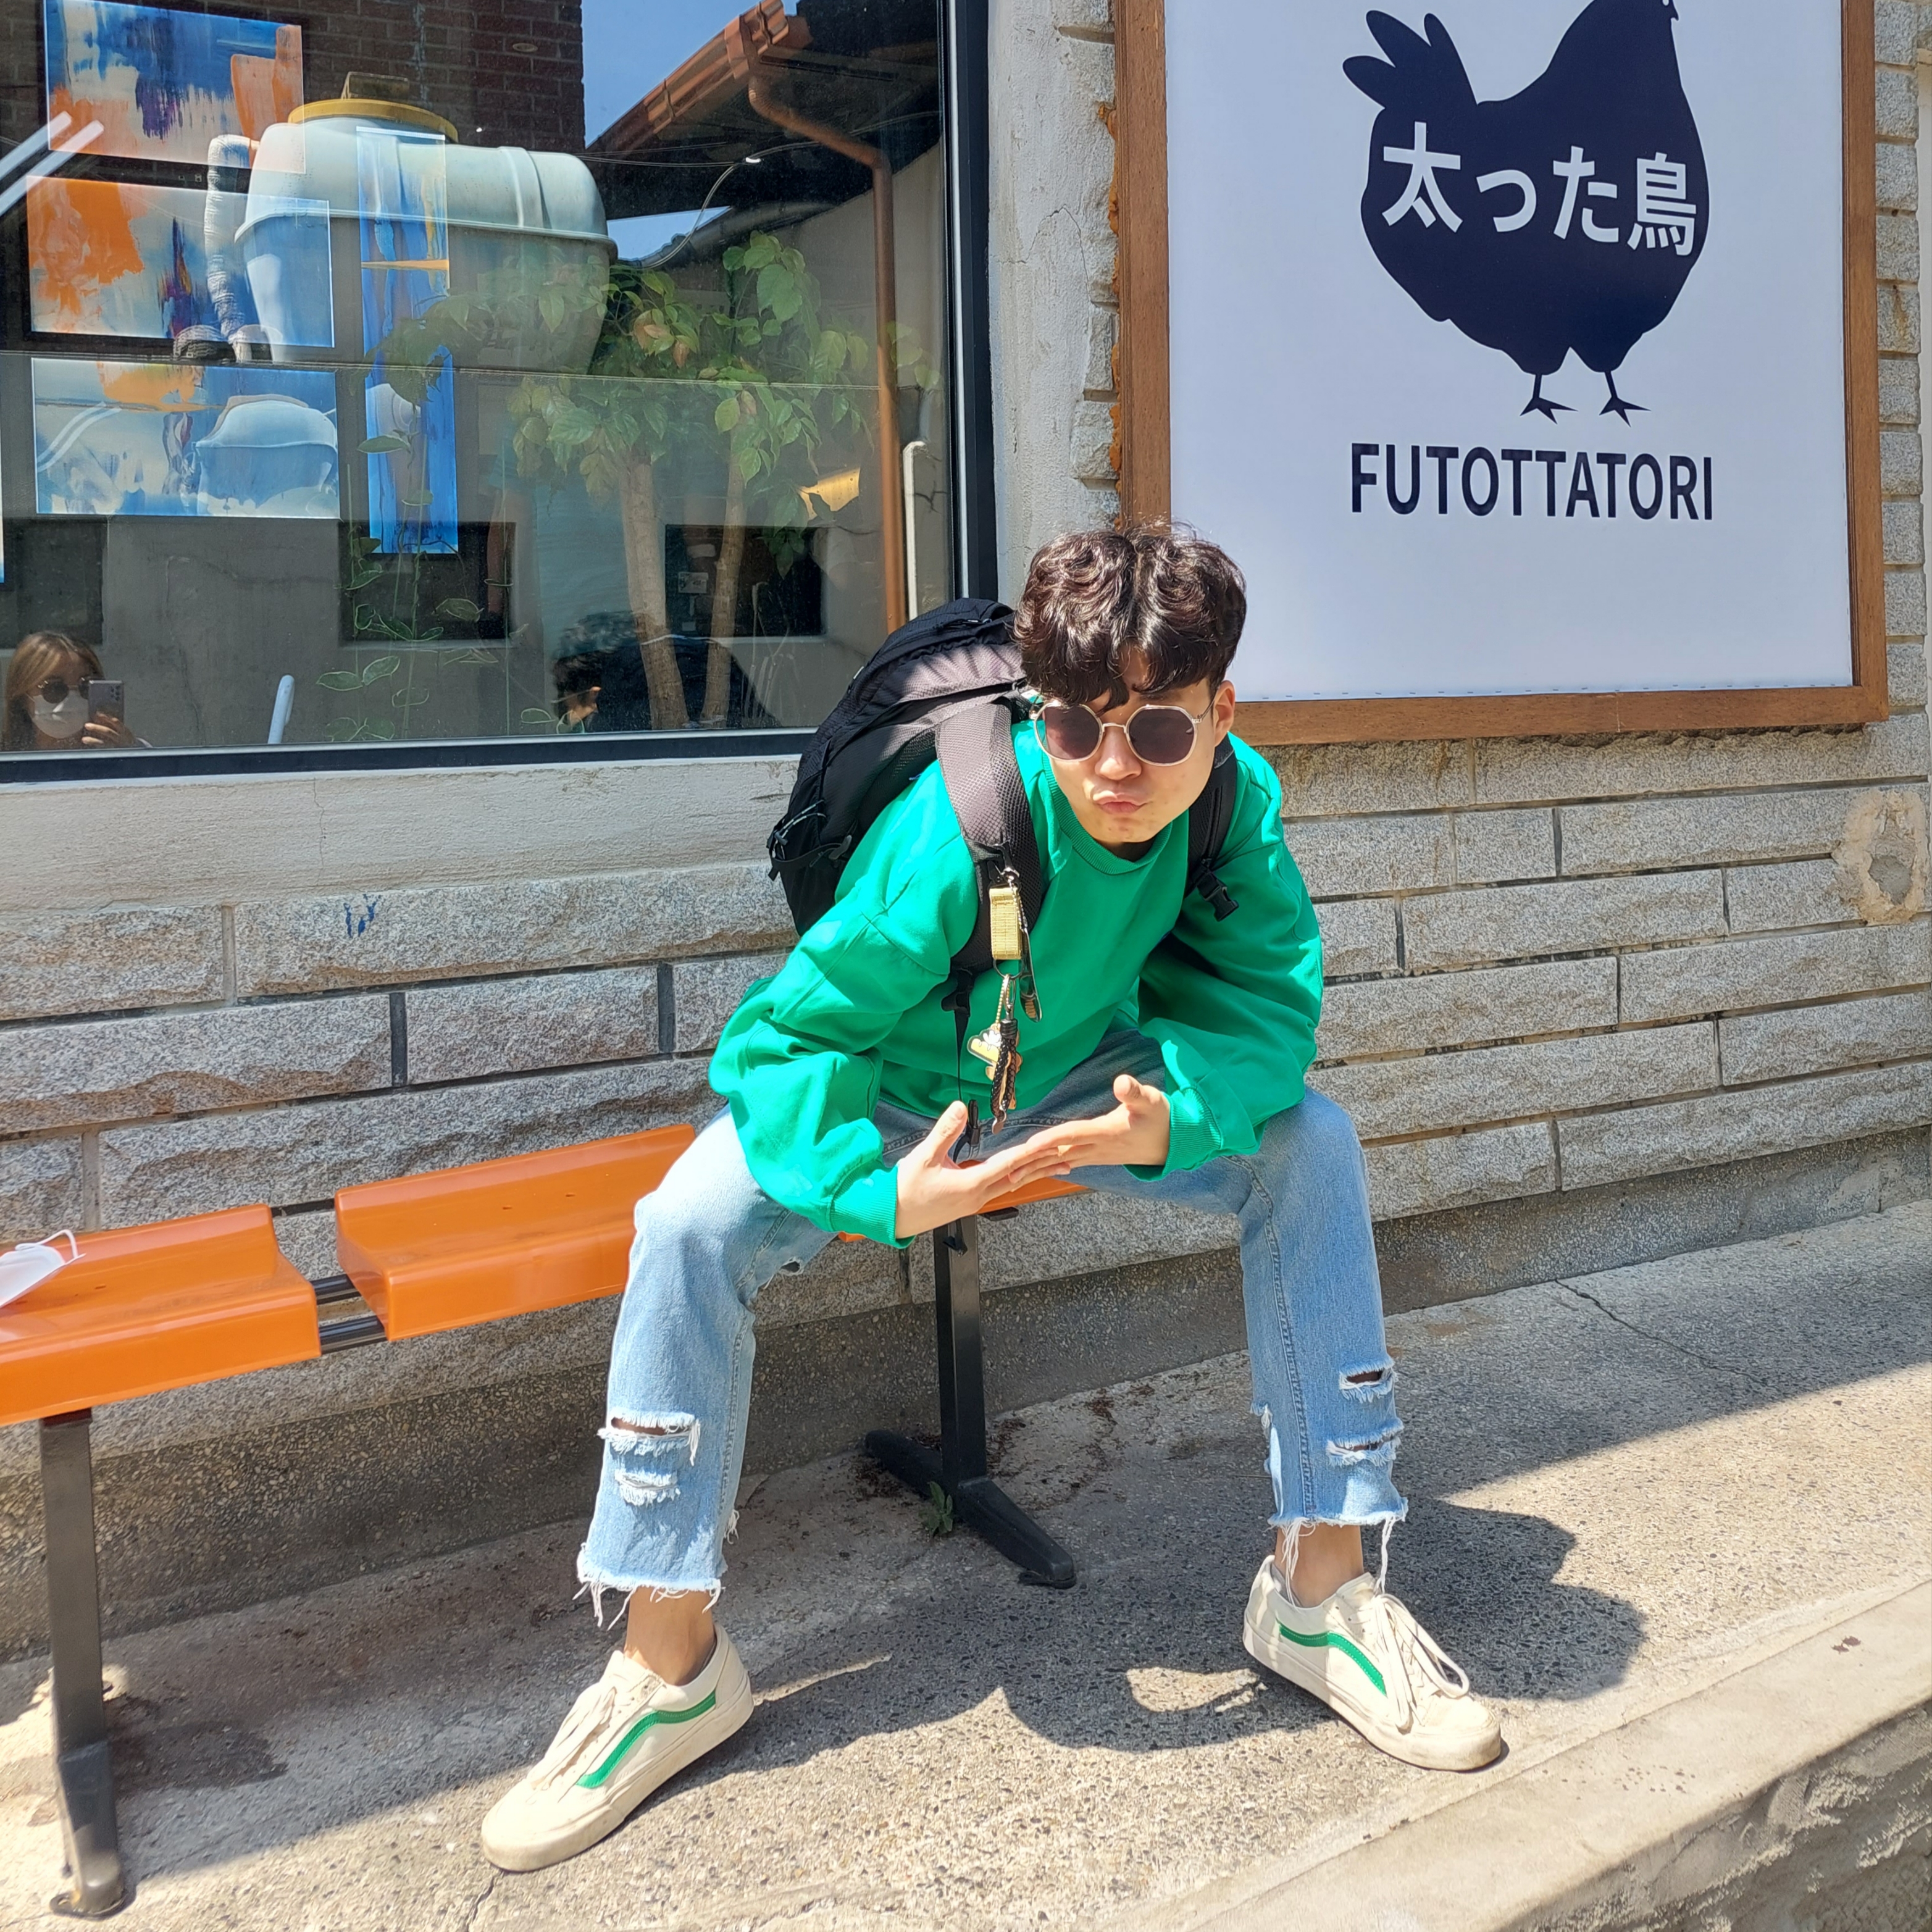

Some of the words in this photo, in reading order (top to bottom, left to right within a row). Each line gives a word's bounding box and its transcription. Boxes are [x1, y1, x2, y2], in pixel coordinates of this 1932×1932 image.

[1382, 122, 1696, 256] 太った鳥
[1352, 443, 1712, 520] FUTOTTATORI
